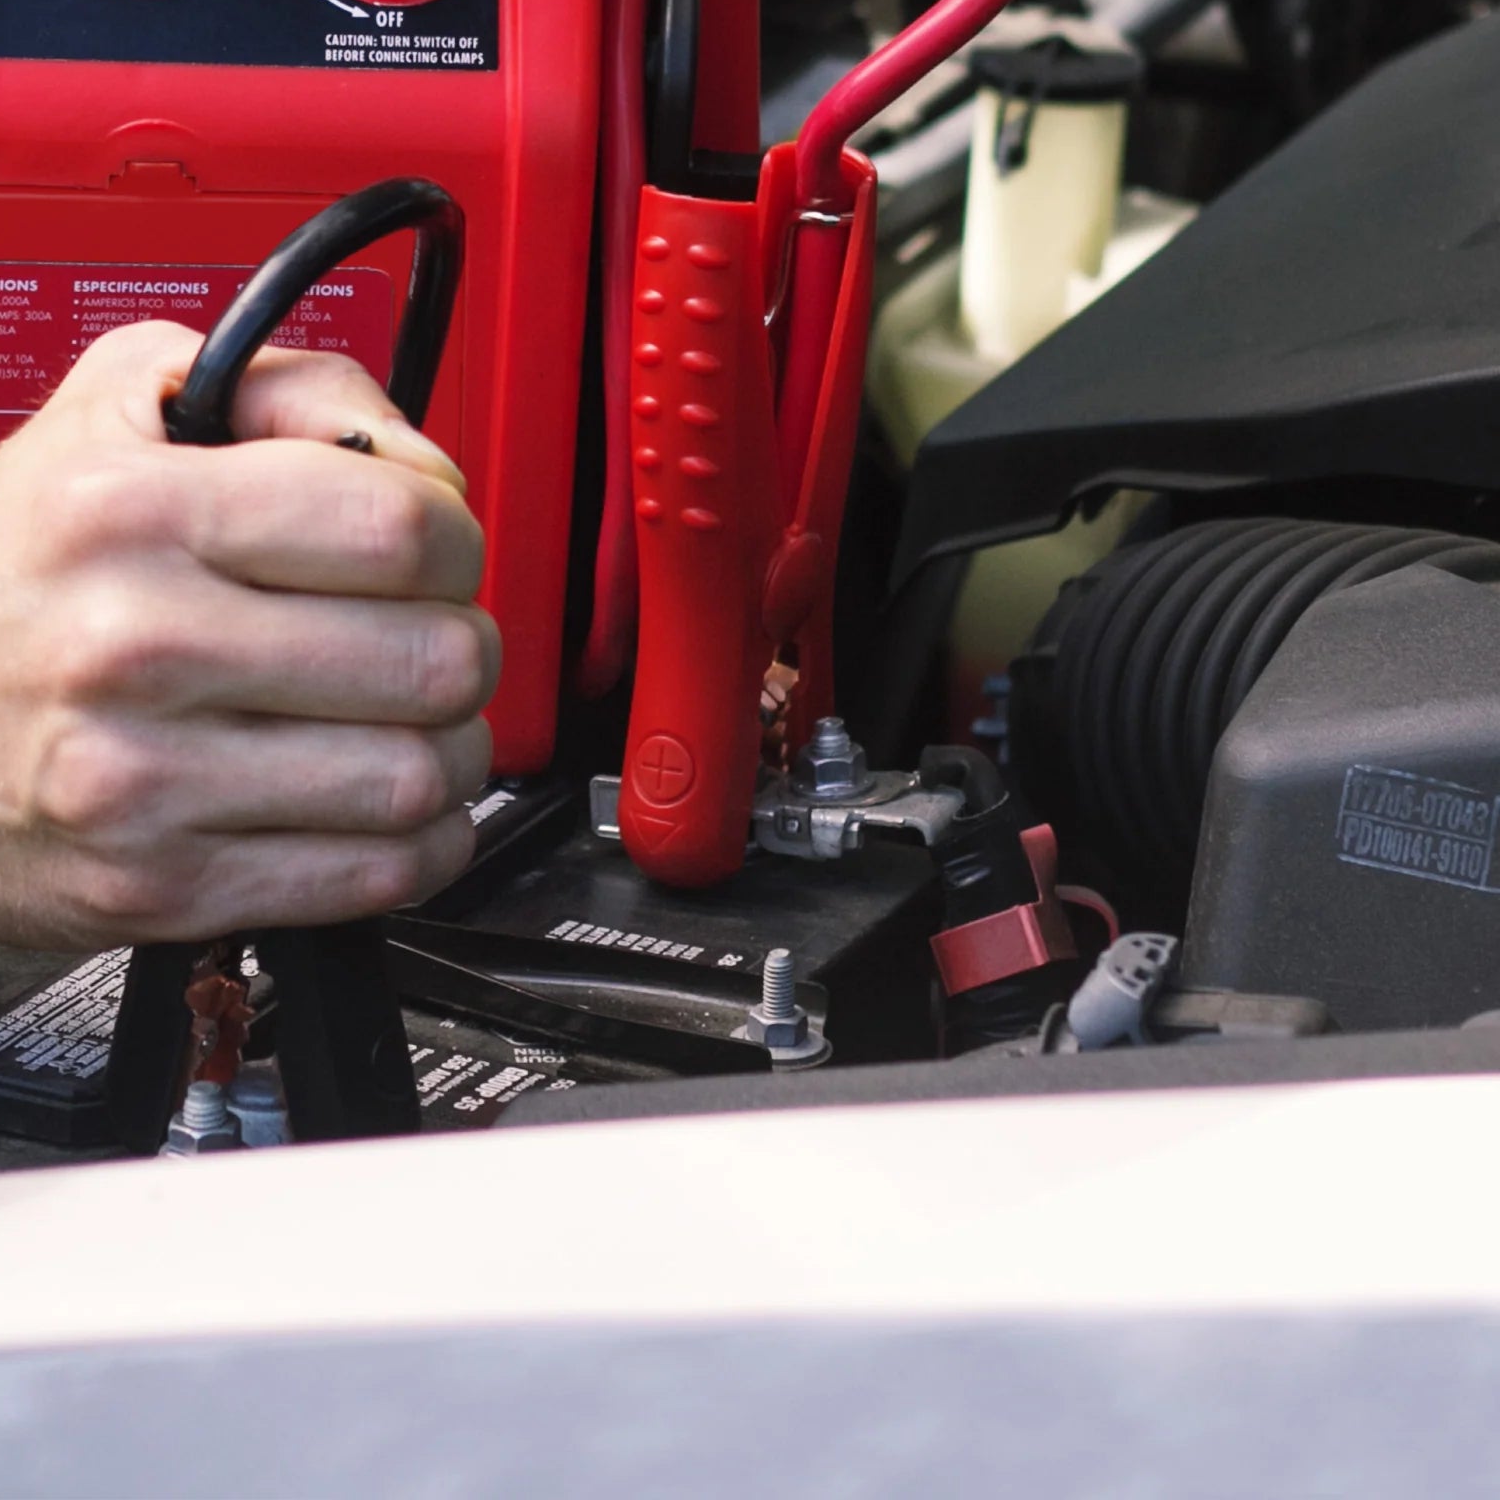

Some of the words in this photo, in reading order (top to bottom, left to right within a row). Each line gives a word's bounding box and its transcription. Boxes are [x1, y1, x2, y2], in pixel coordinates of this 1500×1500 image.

[375, 10, 404, 28] OFF
[325, 33, 378, 47] CAUTION:
[381, 35, 411, 48] TURN
[413, 36, 456, 49] SWITCH
[459, 37, 479, 49] OFF
[325, 49, 365, 63] BEFORE
[368, 50, 438, 64] CONNECTING
[441, 51, 485, 65] CLAMPS
[73, 280, 209, 295] ESPECIFICACIONES
[82, 298, 136, 308] AMPERIOS
[171, 299, 203, 309] 1000A
[300, 301, 315, 311] DE
[24, 311, 52, 322] 300A
[81, 312, 135, 322] AMPERIOS
[323, 313, 332, 322] A
[293, 326, 307, 336] DE
[318, 338, 338, 348] 300
[340, 339, 349, 348] A
[15, 355, 35, 365] 10A
[474, 1066, 529, 1099] GROUP
[453, 1096, 485, 1112] 35
